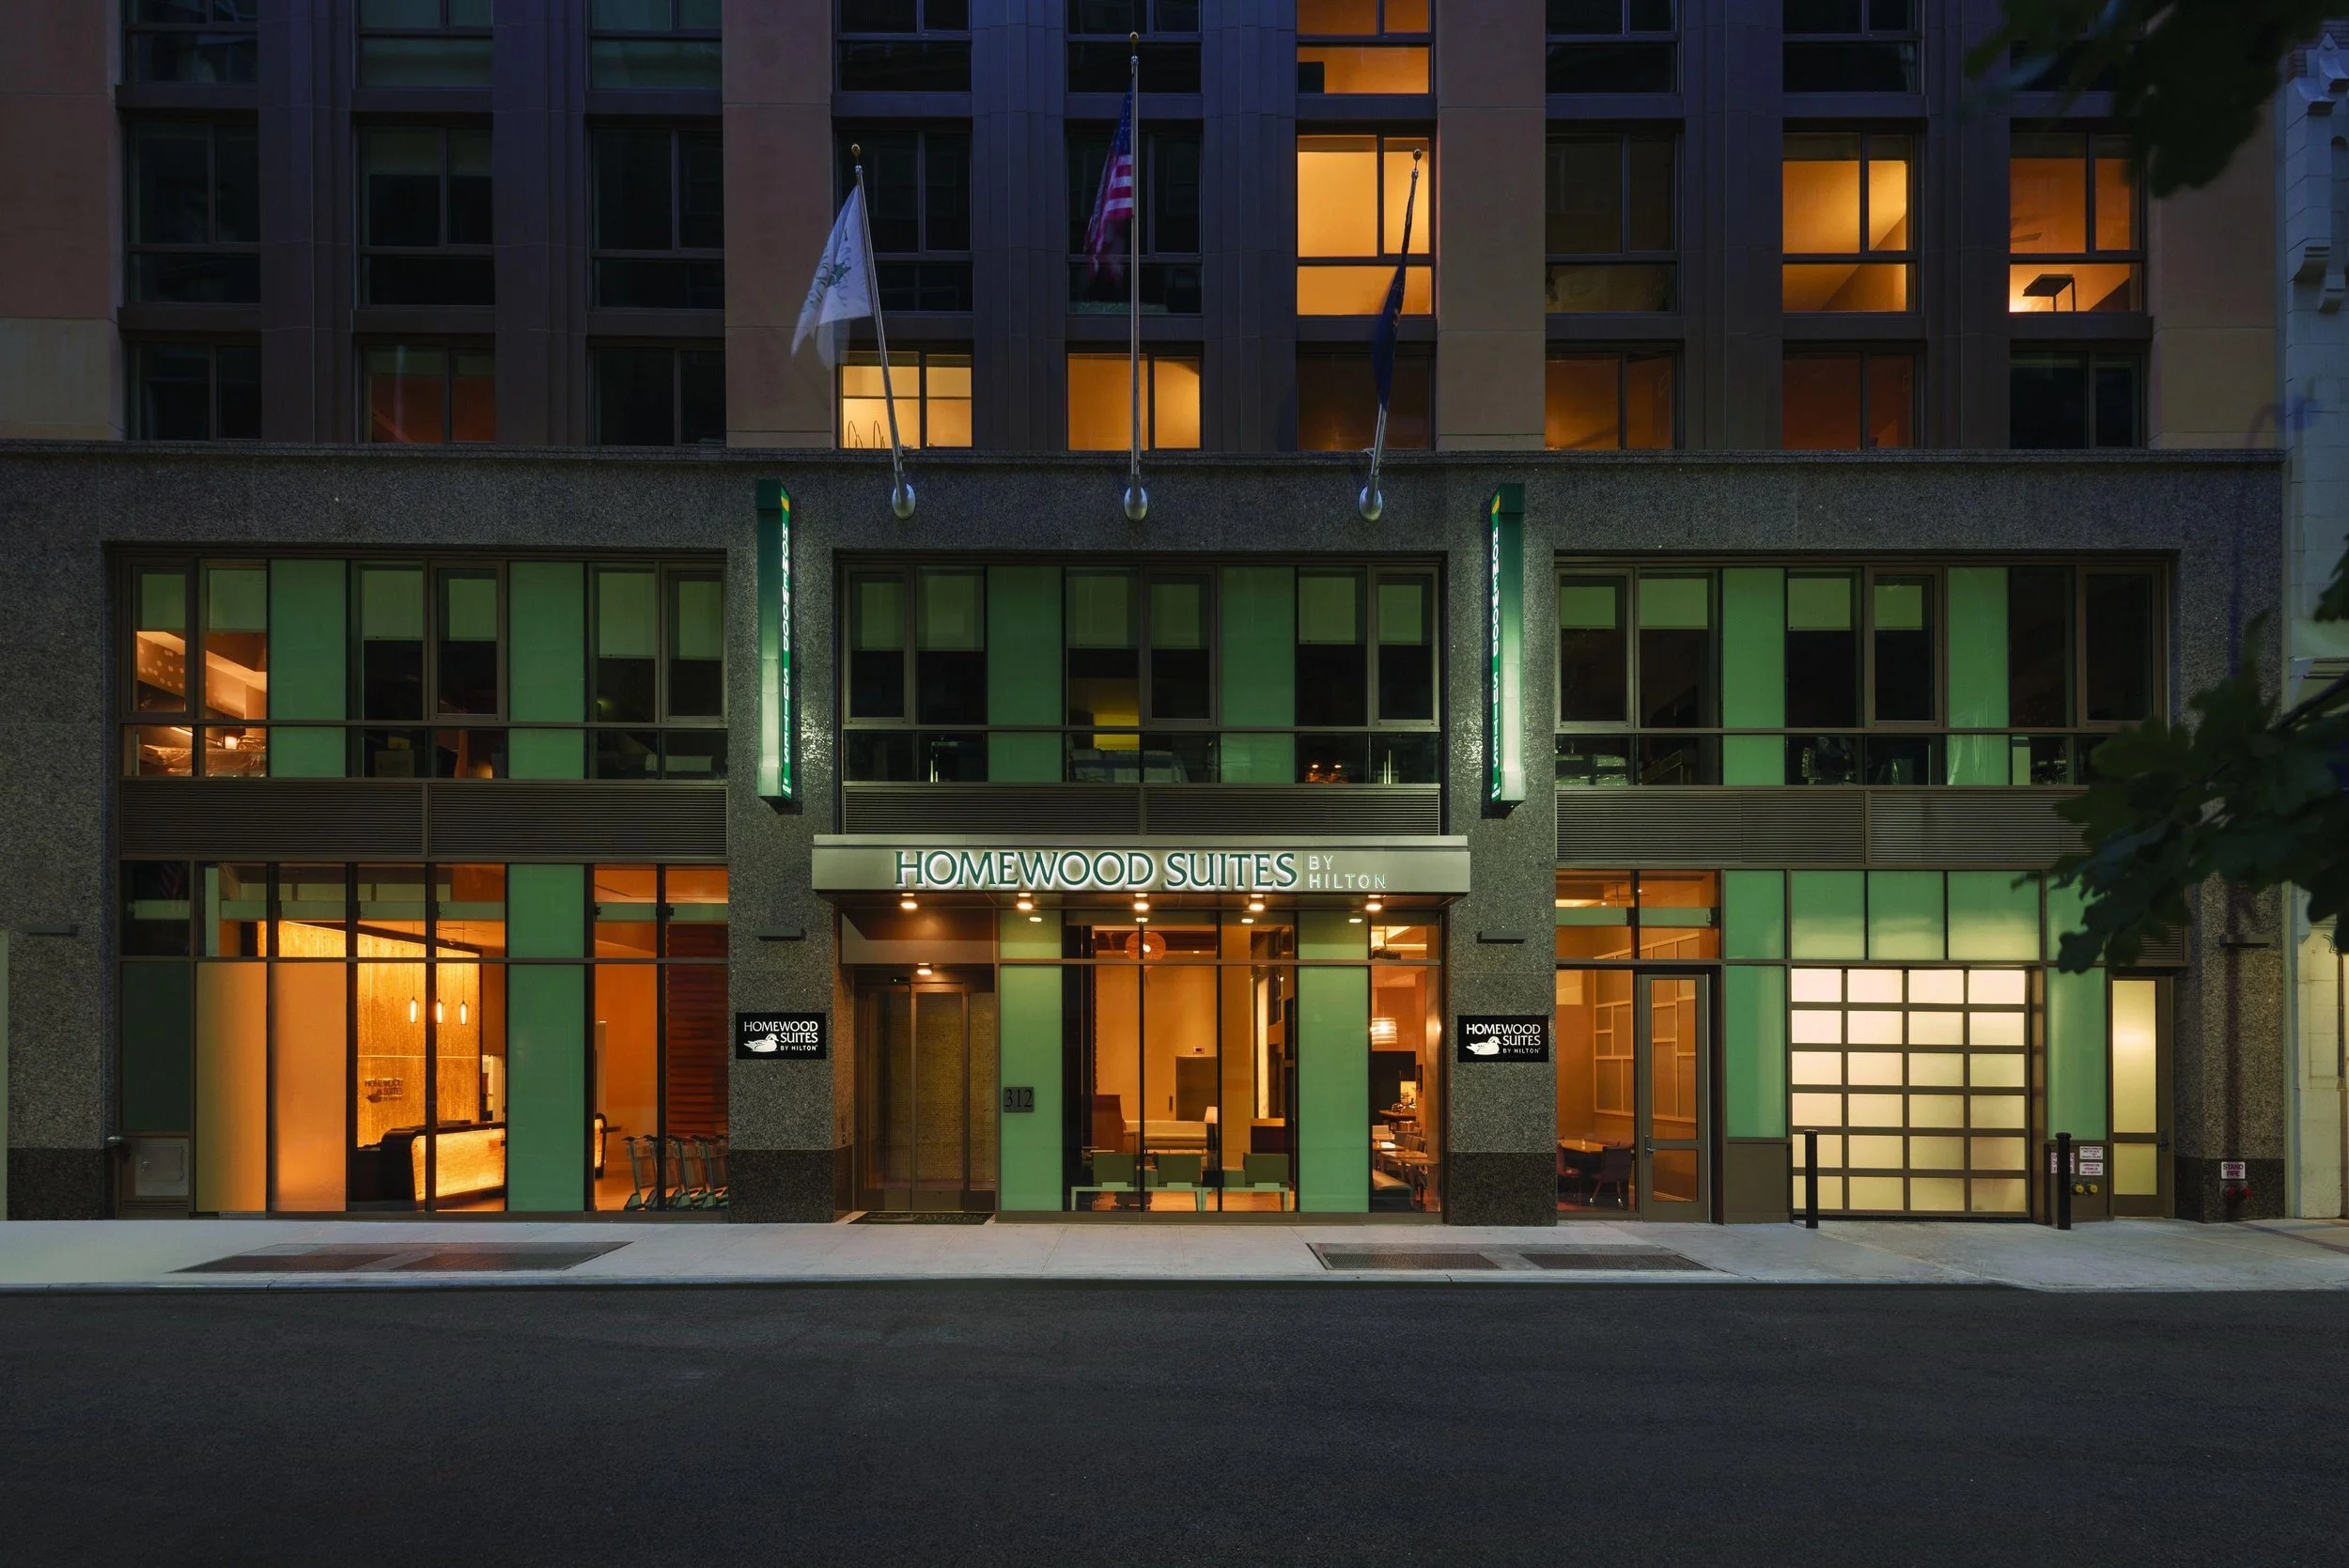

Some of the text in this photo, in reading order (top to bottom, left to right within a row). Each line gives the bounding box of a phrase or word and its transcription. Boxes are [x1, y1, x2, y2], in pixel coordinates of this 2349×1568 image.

[895, 851, 1298, 887] HOMEWOOD SUITES
[1309, 855, 1334, 870] BY
[1309, 873, 1387, 889] HILTON
[743, 1020, 818, 1032] HOMEWOOD
[1466, 1023, 1541, 1035] HOMEWOOD
[780, 1032, 818, 1044] SUITES
[1502, 1034, 1541, 1047] SUITES
[1005, 1089, 1032, 1108] 312
